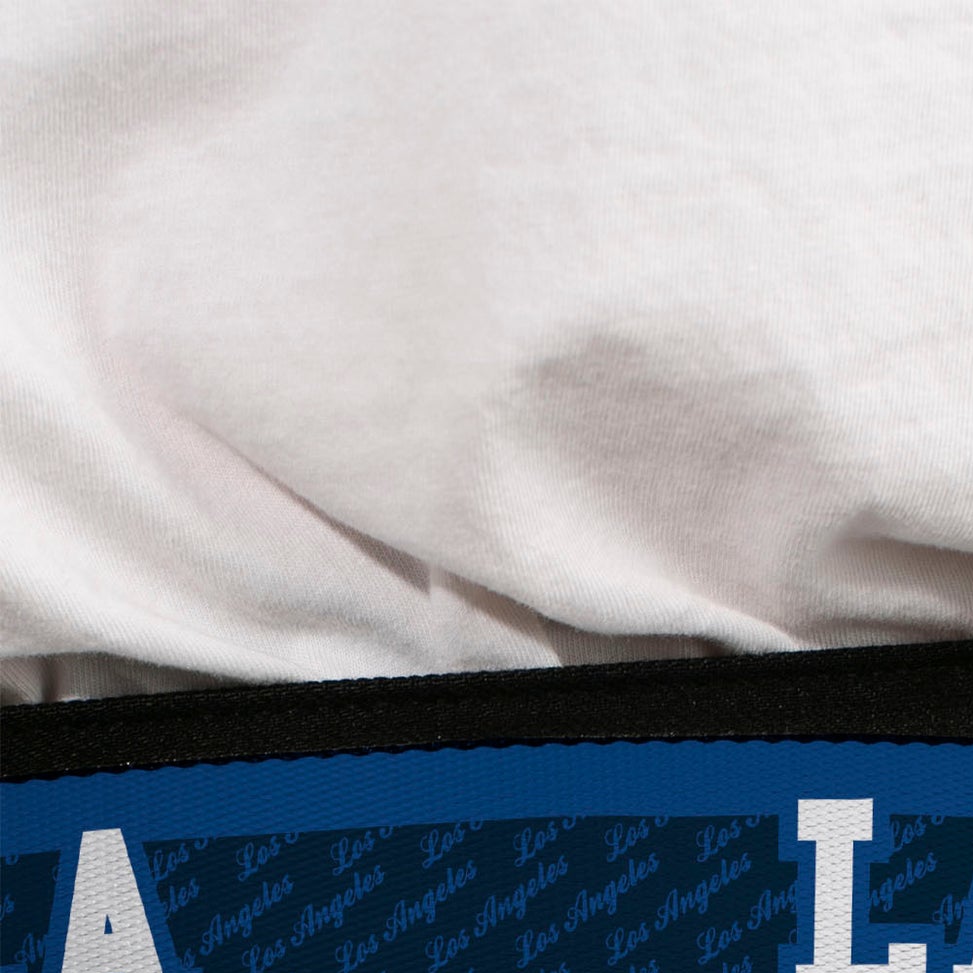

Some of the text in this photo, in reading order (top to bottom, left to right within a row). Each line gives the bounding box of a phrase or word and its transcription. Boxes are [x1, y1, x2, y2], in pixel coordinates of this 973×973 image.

[236, 836, 281, 882] Los
[330, 830, 376, 877] Los
[419, 822, 465, 869] Los
[513, 820, 558, 867] Los
[604, 818, 650, 863] Los
[696, 818, 742, 863] Los
[291, 864, 385, 948] Angeles
[383, 859, 477, 943] Angeles
[473, 854, 569, 938] Angeles
[870, 851, 937, 912] ngeles
[200, 873, 294, 956] Angeles
[515, 852, 660, 969] Los Angeles
[605, 921, 650, 967] Los
[654, 852, 752, 932] Angeles
[696, 920, 743, 966] Los
